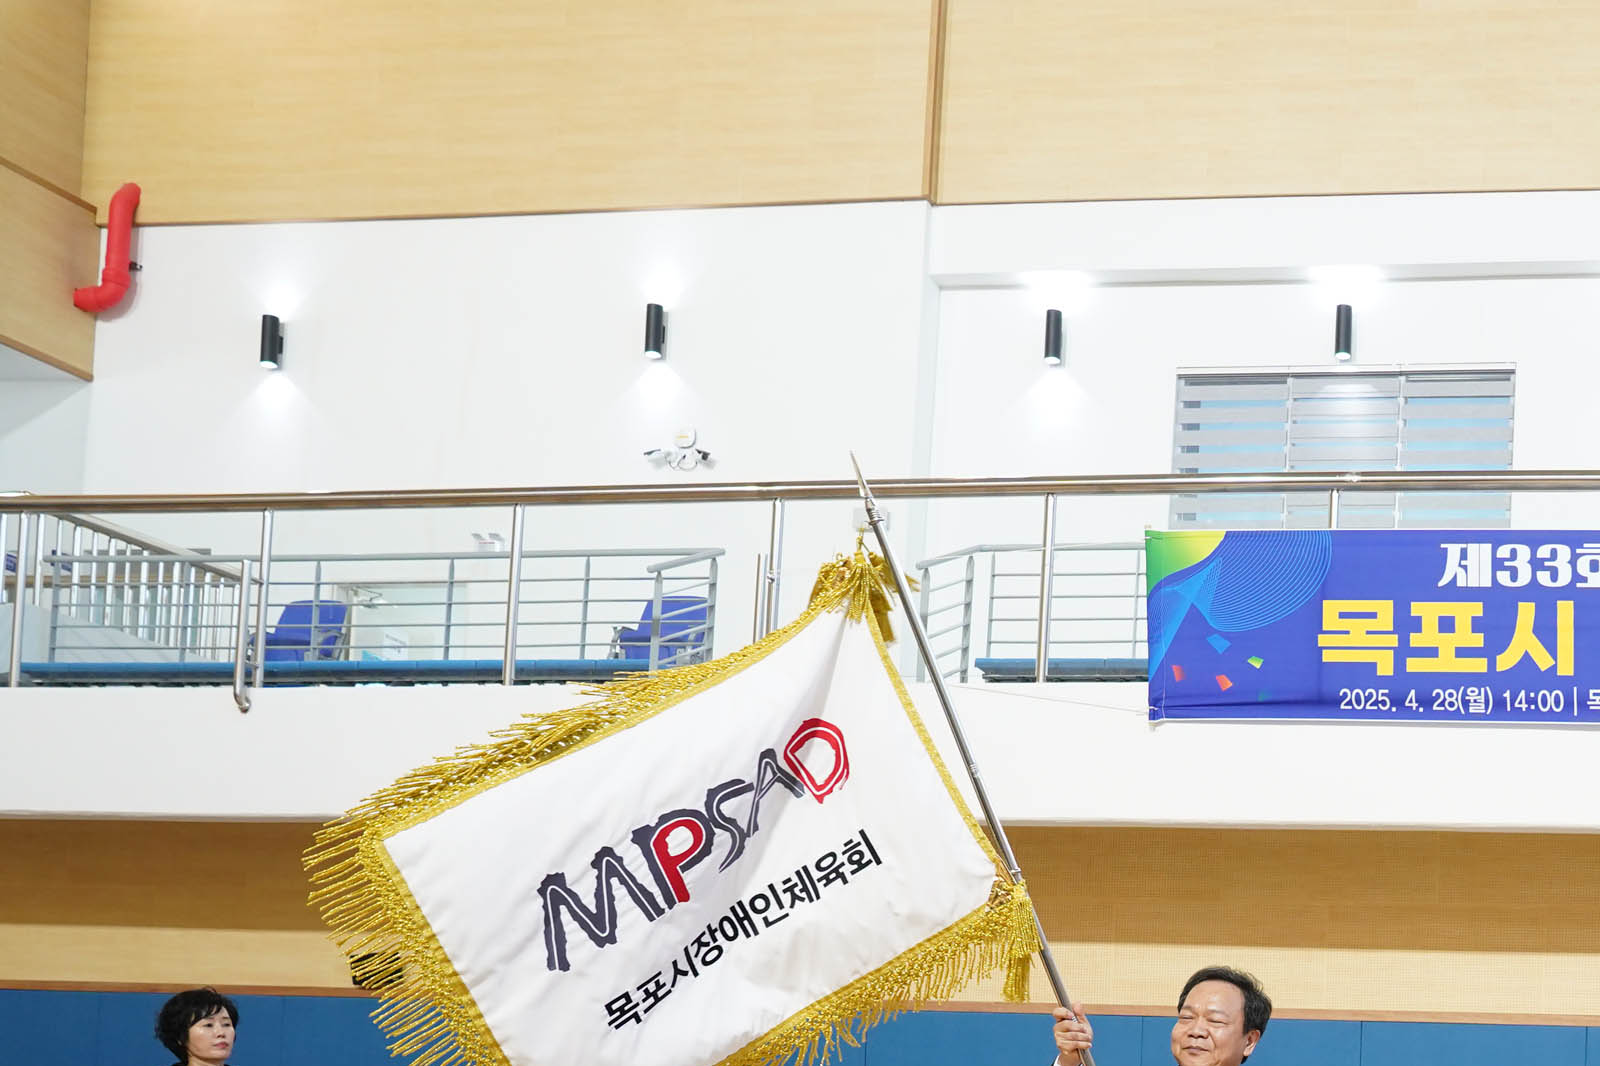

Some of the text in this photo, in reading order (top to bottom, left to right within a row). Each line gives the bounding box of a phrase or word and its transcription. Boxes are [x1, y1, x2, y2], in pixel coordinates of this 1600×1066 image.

[1317, 598, 1575, 677] 목포시
[1339, 686, 1565, 715] 2025. 4. 28(월) 14:00
[603, 828, 885, 1030] 목포시장애인체육회
